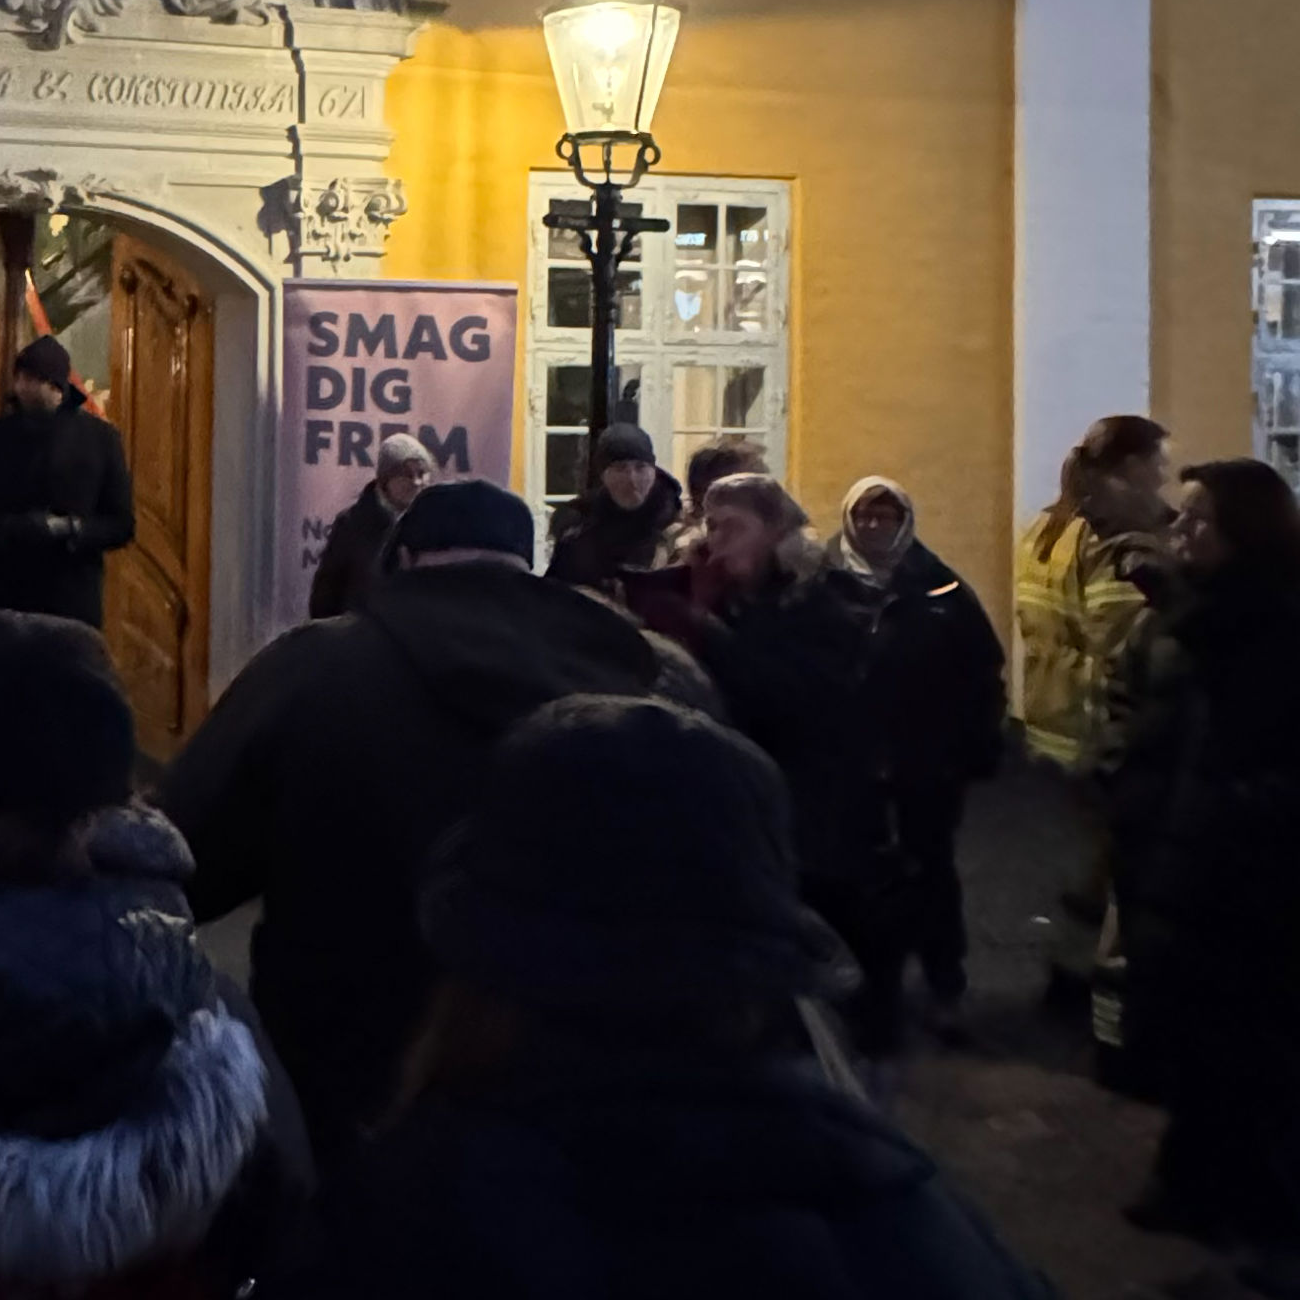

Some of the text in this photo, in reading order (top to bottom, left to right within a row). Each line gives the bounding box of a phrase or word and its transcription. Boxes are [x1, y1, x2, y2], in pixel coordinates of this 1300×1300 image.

[306, 310, 491, 363] SMAG
[305, 365, 413, 415] DIG
[304, 419, 471, 473] FRM
